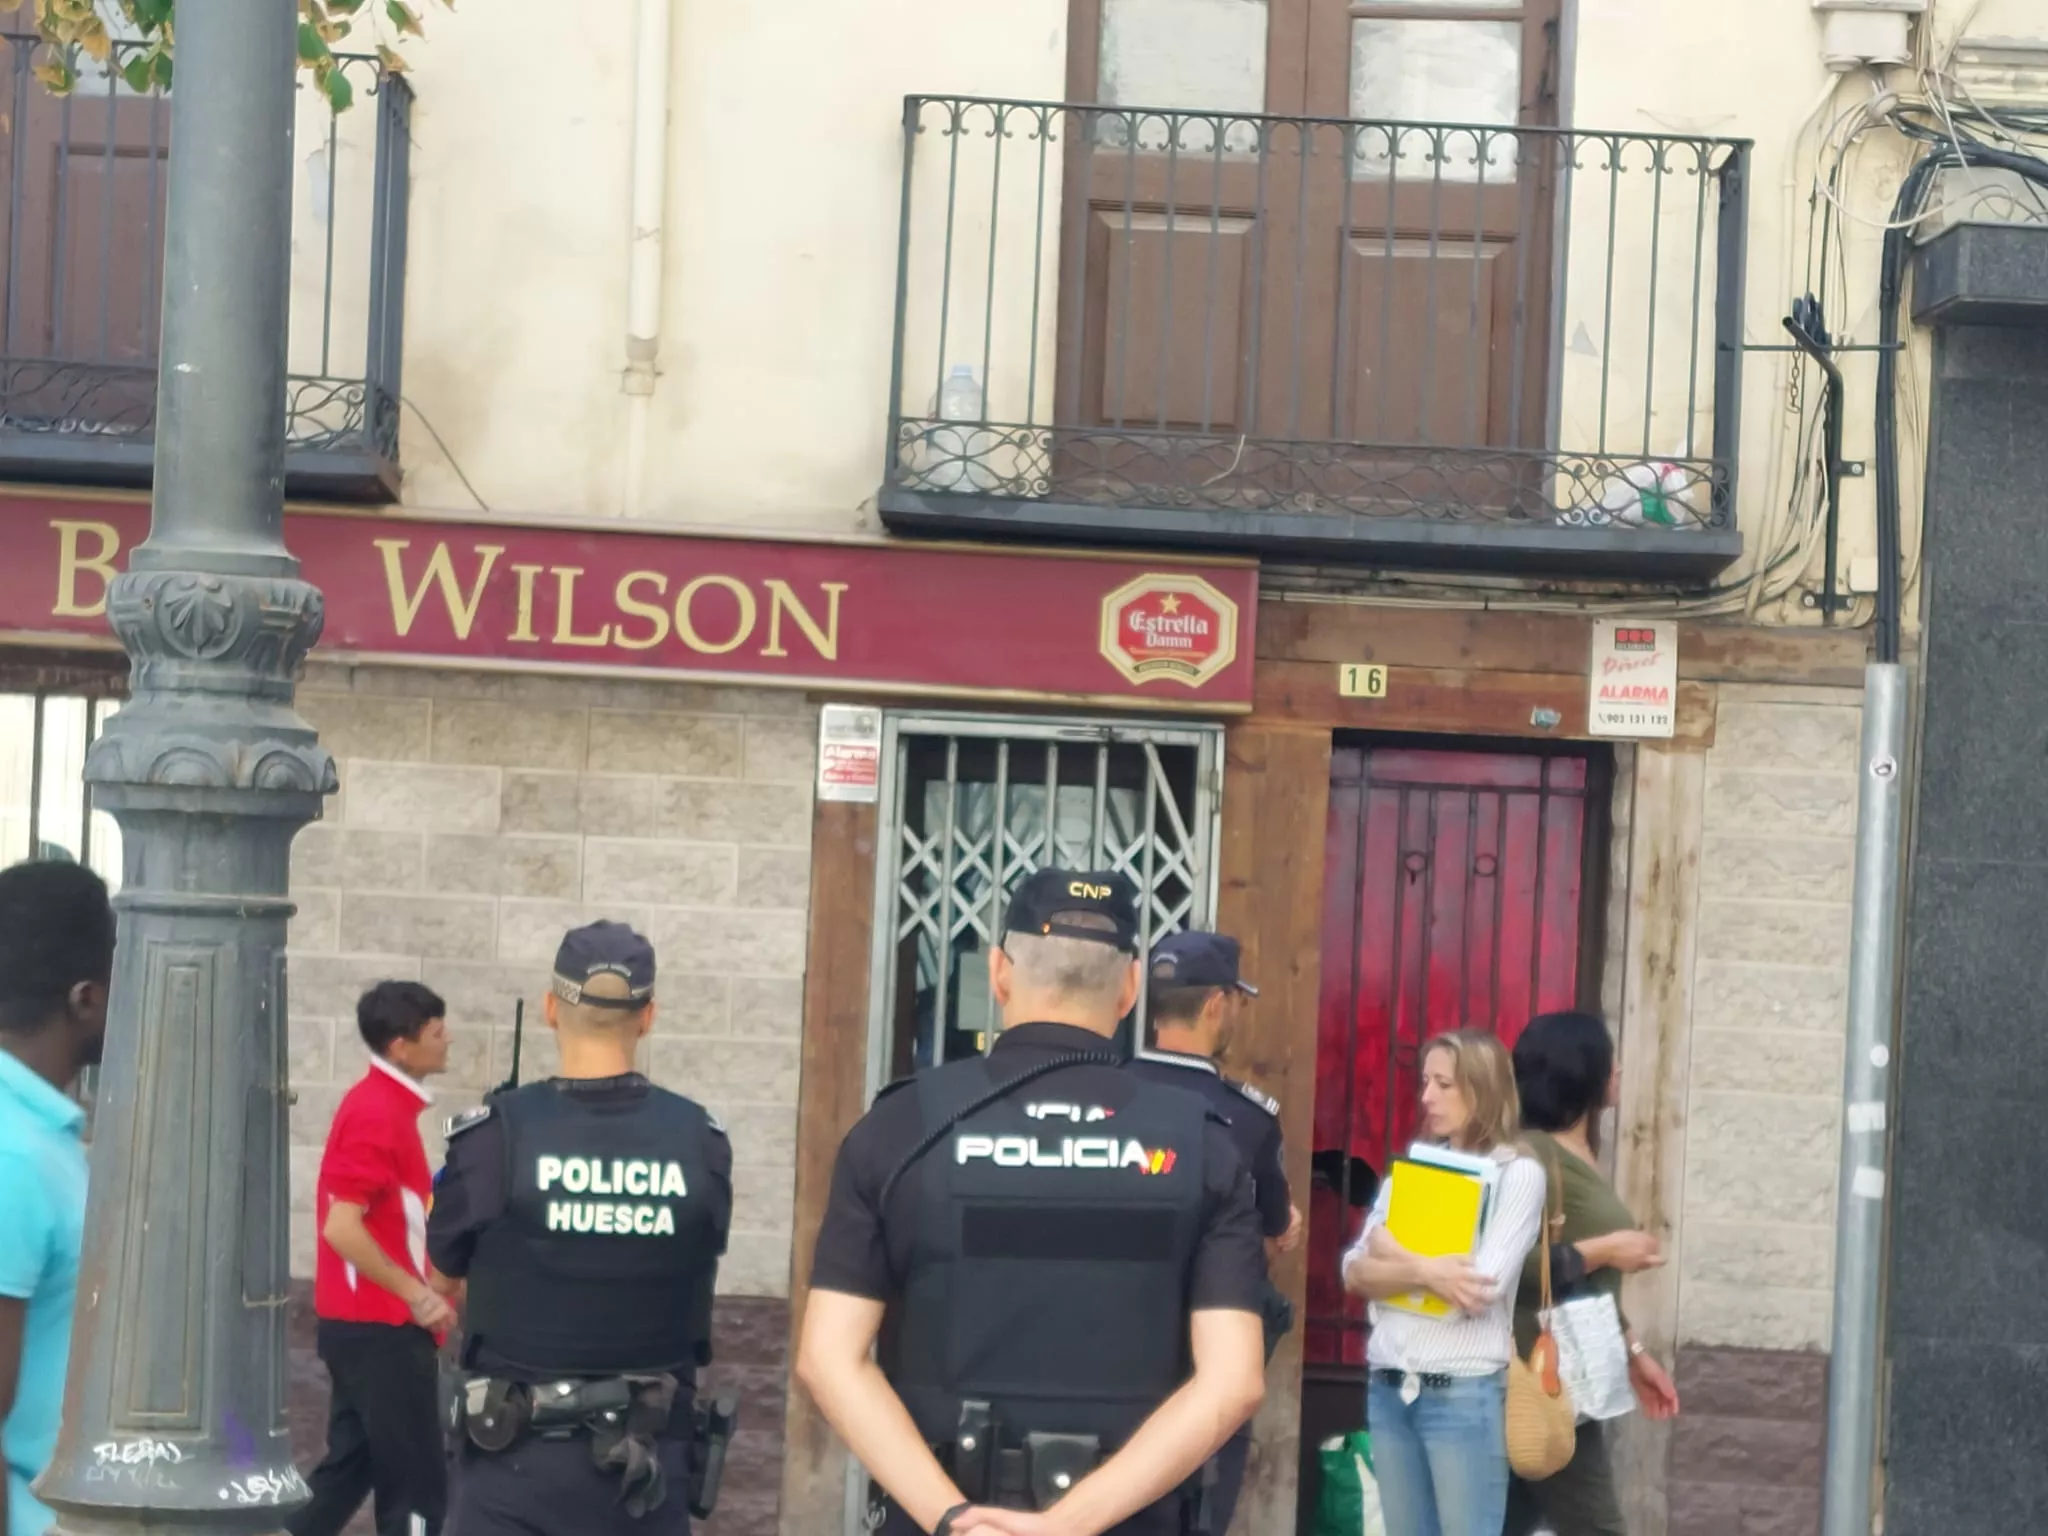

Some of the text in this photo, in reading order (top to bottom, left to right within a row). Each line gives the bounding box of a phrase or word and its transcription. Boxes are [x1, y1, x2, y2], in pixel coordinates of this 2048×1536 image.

[1129, 610, 1209, 635] Estrella
[1146, 633, 1193, 648] Damm
[1347, 667, 1382, 695] 16
[1599, 684, 1669, 702] ALARMA
[1068, 881, 1112, 900] CNP
[956, 1136, 1151, 1169] POLICIA
[537, 1156, 687, 1197] POLICIA
[547, 1201, 676, 1236] HUESCA
